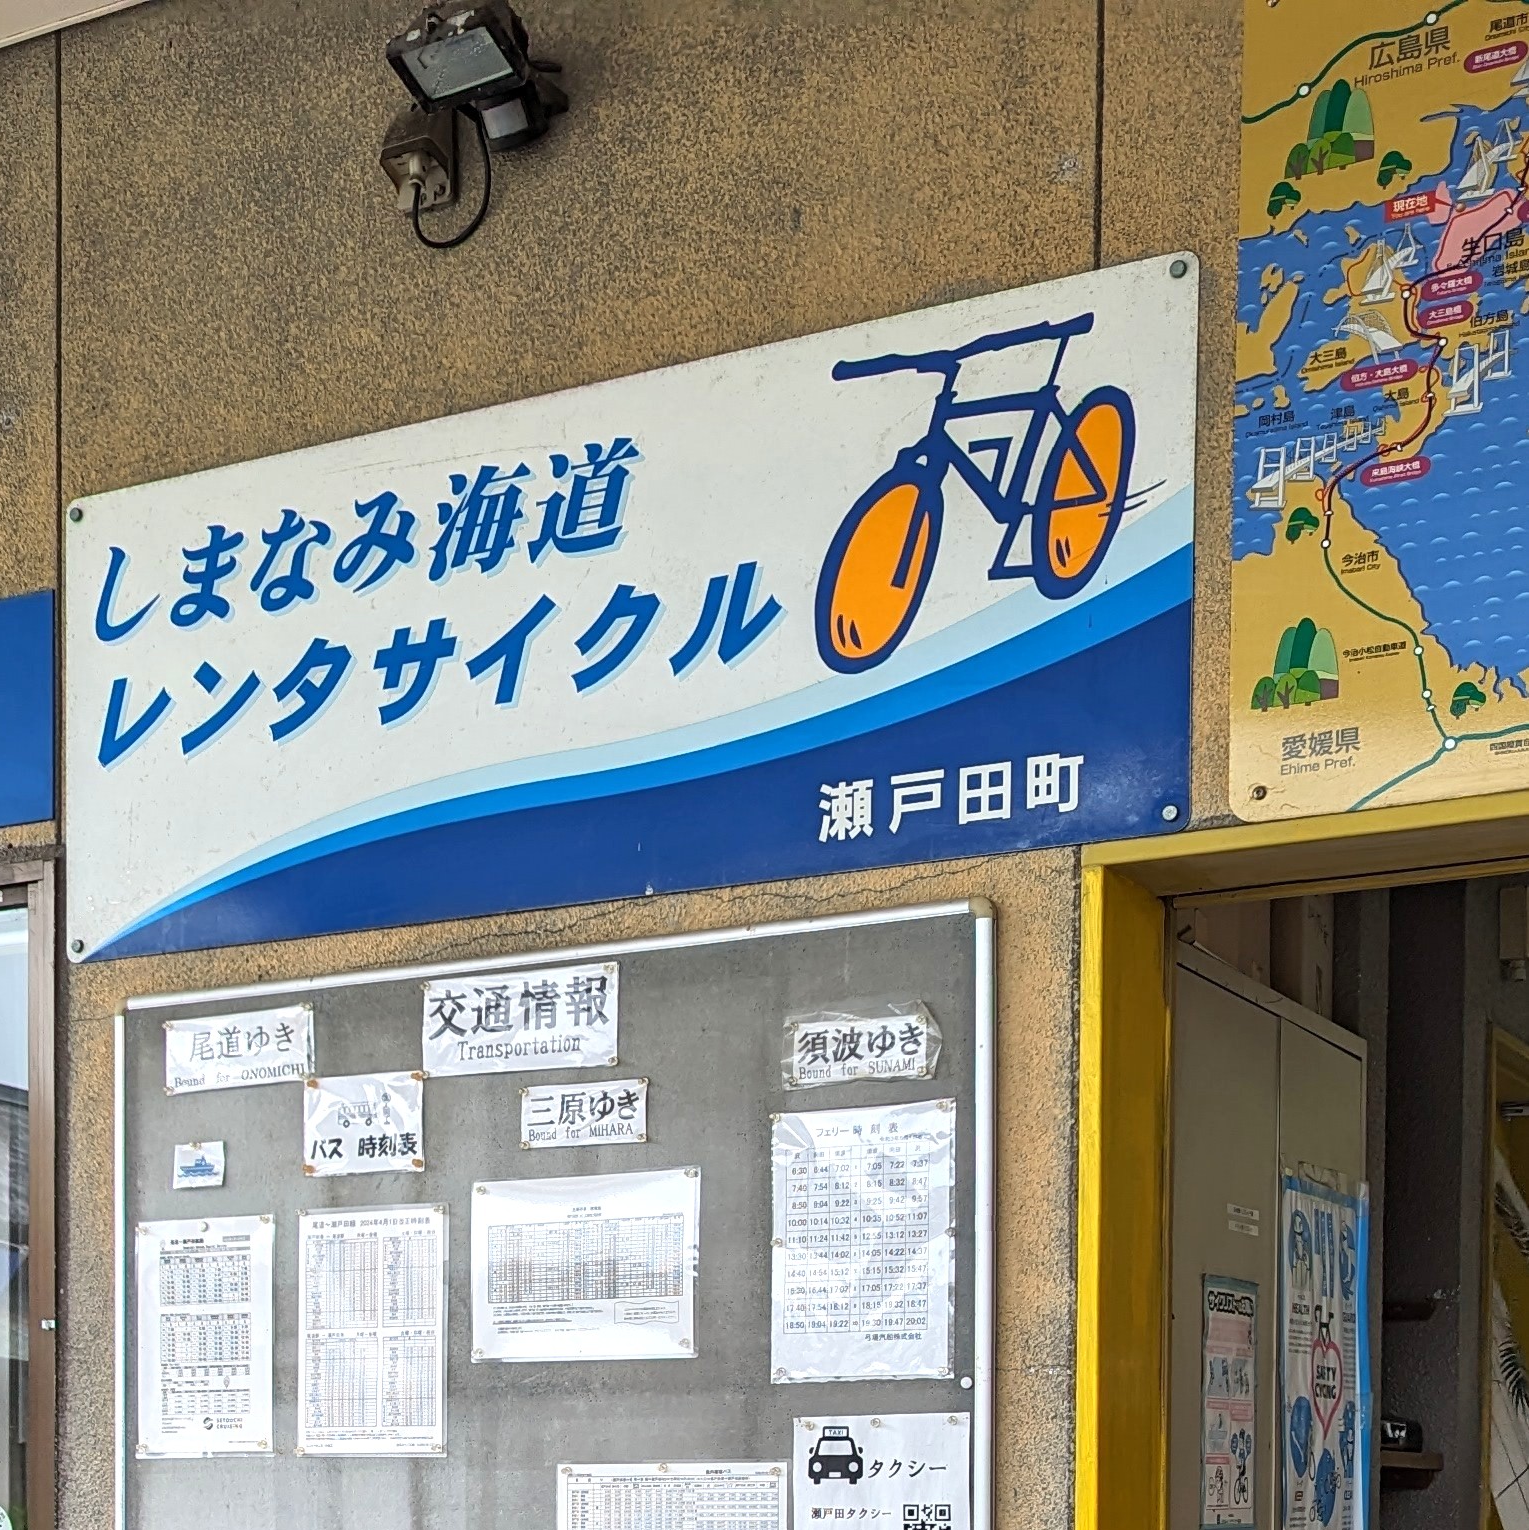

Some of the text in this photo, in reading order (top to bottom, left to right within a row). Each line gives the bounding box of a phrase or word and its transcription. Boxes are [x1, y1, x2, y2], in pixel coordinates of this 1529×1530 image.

[1369, 26, 1450, 69] 広島県
[1354, 63, 1422, 87] Hiroshima
[1428, 52, 1460, 69] Pref.
[1393, 195, 1428, 212] 現在地
[1310, 348, 1347, 365] 大三島
[1385, 388, 1409, 402] 大島
[1259, 410, 1295, 427] 岡村島
[92, 437, 640, 644] しまなみ海道
[1342, 550, 1379, 567] 今治市
[98, 561, 787, 770] レンタサイクル
[1281, 727, 1361, 761] 愛媛県
[1280, 756, 1356, 777] Ehime Pref.
[817, 752, 1085, 845] 瀬戸田町
[427, 976, 610, 1040] 交通情報
[190, 1021, 296, 1062] 尾道ゆき
[458, 1034, 582, 1062] Transportation
[798, 1022, 925, 1065] 須波ゆき
[241, 1063, 305, 1080] ONOMICHI
[799, 1058, 917, 1080] Bound for SUNAMI
[528, 1090, 640, 1126] 三原ゆき
[528, 1122, 634, 1142] Bound for MIHARA
[311, 1132, 417, 1160] バス 時刻表
[908, 1212, 928, 1220] 11:07
[885, 1231, 905, 1239] 13:12
[885, 1248, 905, 1256] 14:22
[884, 1265, 904, 1273] 15:32
[868, 1459, 947, 1478] タクシー
[811, 1507, 892, 1519] 瀬戸田タクシー
